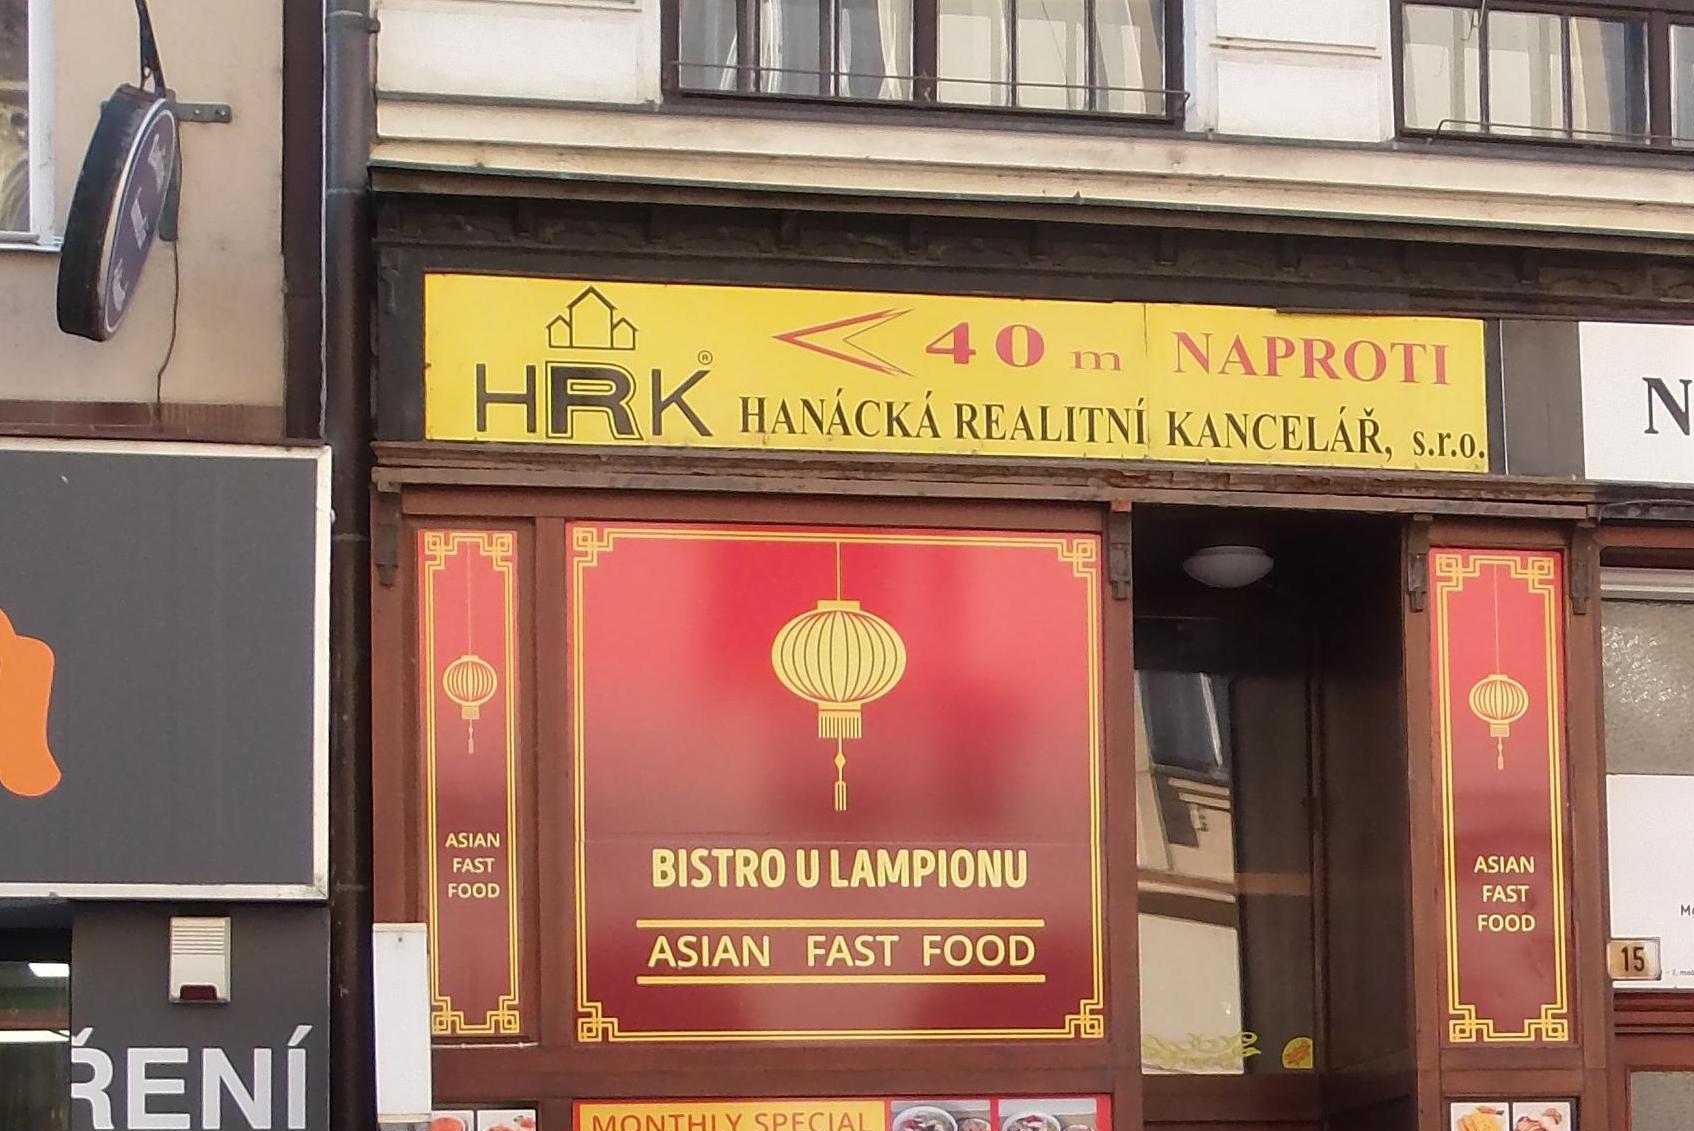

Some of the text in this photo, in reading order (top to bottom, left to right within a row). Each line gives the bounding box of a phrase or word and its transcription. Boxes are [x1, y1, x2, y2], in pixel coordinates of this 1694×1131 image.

[926, 321, 1451, 386] 40 m NAPROTI
[738, 388, 1487, 462] HANÁCKÁ REALITNÍ KANCELÁŘ, s.r.o.
[444, 832, 501, 849] ASIAN
[452, 857, 495, 874] FAST
[650, 848, 1028, 889] BISTRO U LAMPIONU
[1473, 855, 1535, 874] ASIAN
[447, 882, 501, 899] FOOD
[1482, 885, 1530, 903] FAST
[1477, 914, 1536, 933] FOOD
[647, 934, 1036, 968] ASIAN FAST FOOD
[1620, 946, 1645, 972] 15
